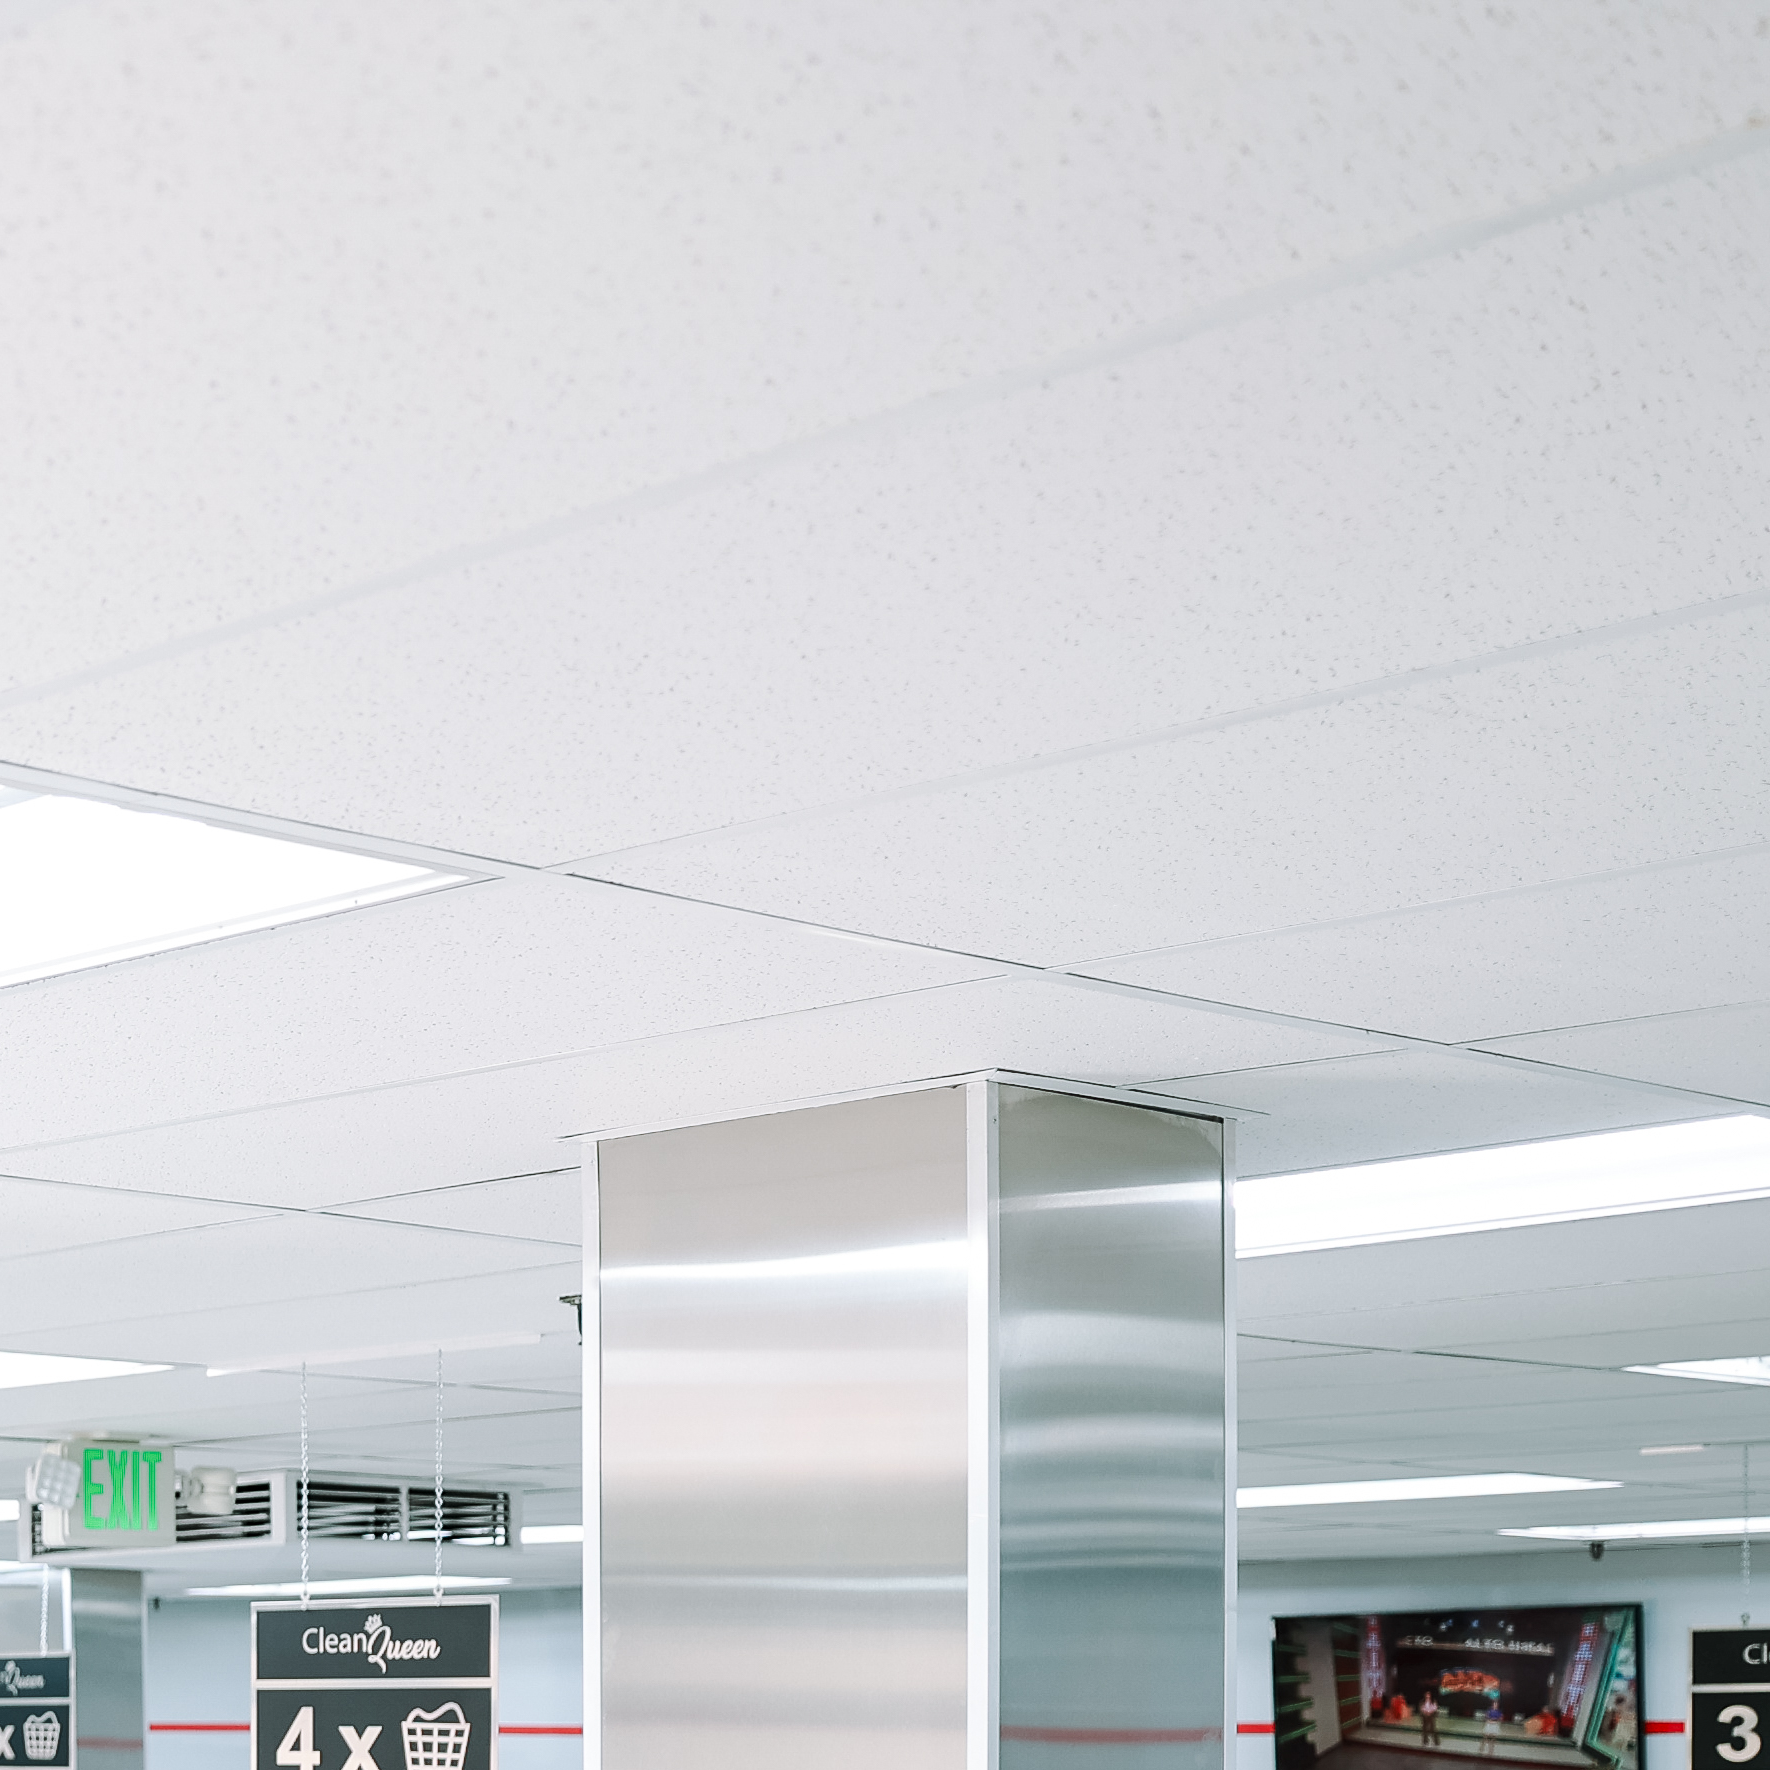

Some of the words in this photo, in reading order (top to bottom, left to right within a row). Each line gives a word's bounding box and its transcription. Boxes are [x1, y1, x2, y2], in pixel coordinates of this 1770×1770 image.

[83, 1448, 162, 1531] EXIT
[1743, 1642, 1770, 1665] Cl
[1715, 1703, 1762, 1763] 3
